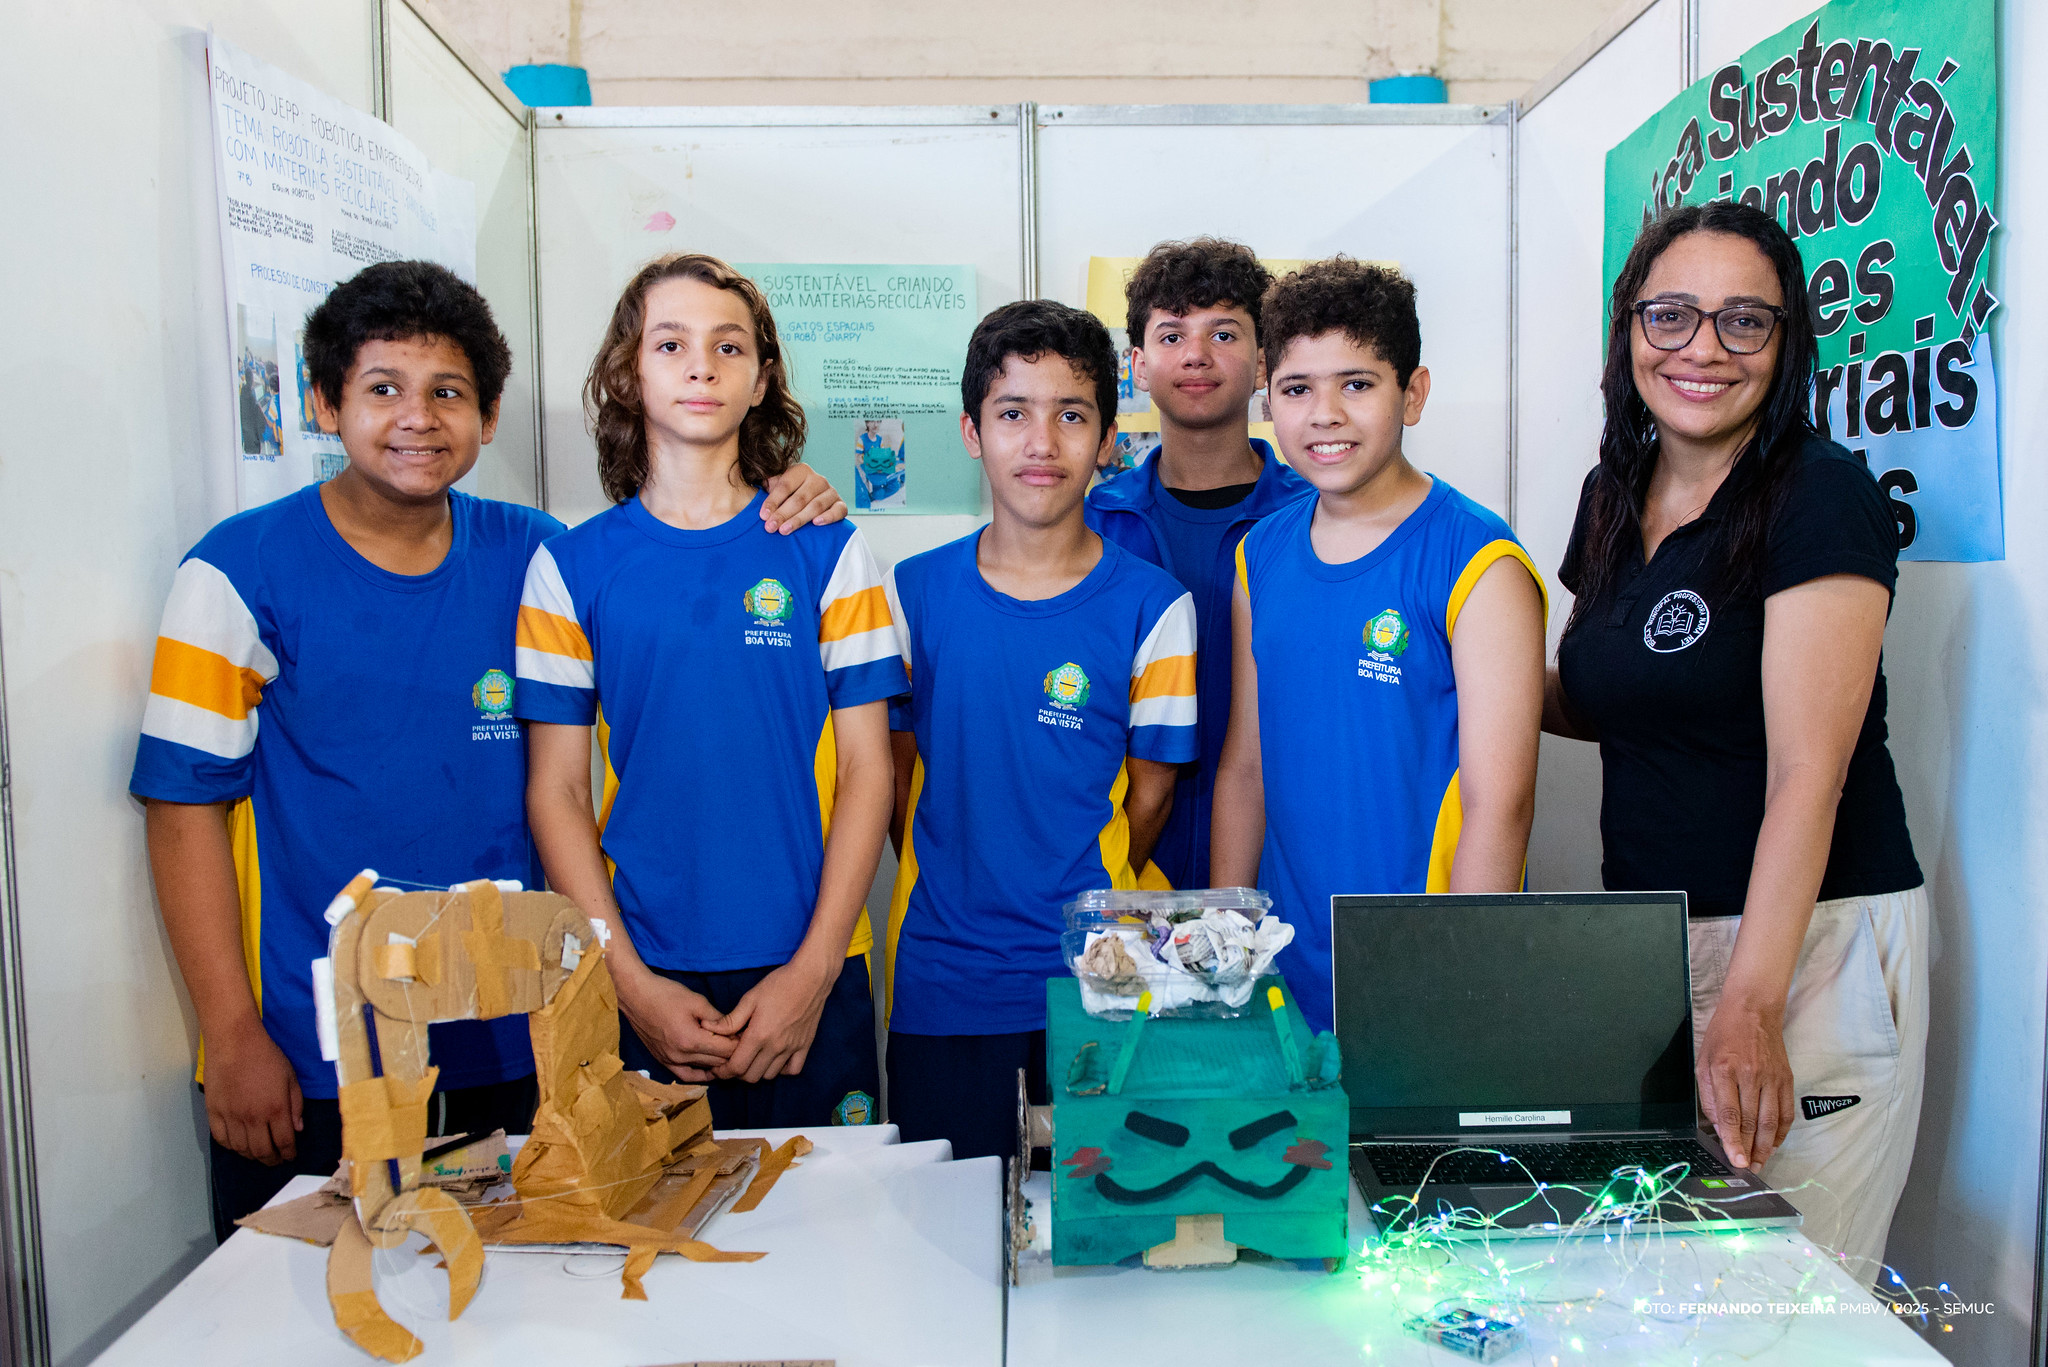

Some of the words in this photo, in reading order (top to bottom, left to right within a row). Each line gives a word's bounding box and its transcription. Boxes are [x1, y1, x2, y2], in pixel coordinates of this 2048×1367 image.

[214, 65, 266, 112] PROJETO
[226, 136, 259, 167] COM
[263, 151, 330, 195] MATERIAIS
[250, 263, 291, 285] PROCESSO
[887, 276, 953, 293] CRIANDO
[1808, 239, 1897, 337] es
[770, 293, 794, 308] OM
[878, 292, 966, 310] RECICLÁVEIS
[788, 321, 824, 332] GATOS
[826, 322, 875, 332] ESPACIAIS
[823, 331, 862, 342] GNARPY
[1815, 313, 1979, 439] riais
[1673, 592, 1707, 616] PROFESSORA
[1692, 616, 1707, 635] NARA
[744, 630, 792, 639] PREFEITURA
[745, 636, 765, 645] BOA
[766, 637, 792, 648] VISTA
[1680, 634, 1695, 647] NEY
[1357, 667, 1374, 679] BOA
[1374, 671, 1400, 685] VISTA
[1358, 659, 1402, 676] PREFEITURA
[1037, 714, 1057, 726] BOA
[1057, 718, 1082, 731] VISTA
[472, 731, 492, 741] BOA
[493, 730, 520, 740] VISTA
[1805, 1098, 1853, 1116] THWYGZR
[1514, 1113, 1546, 1122] Carolina
